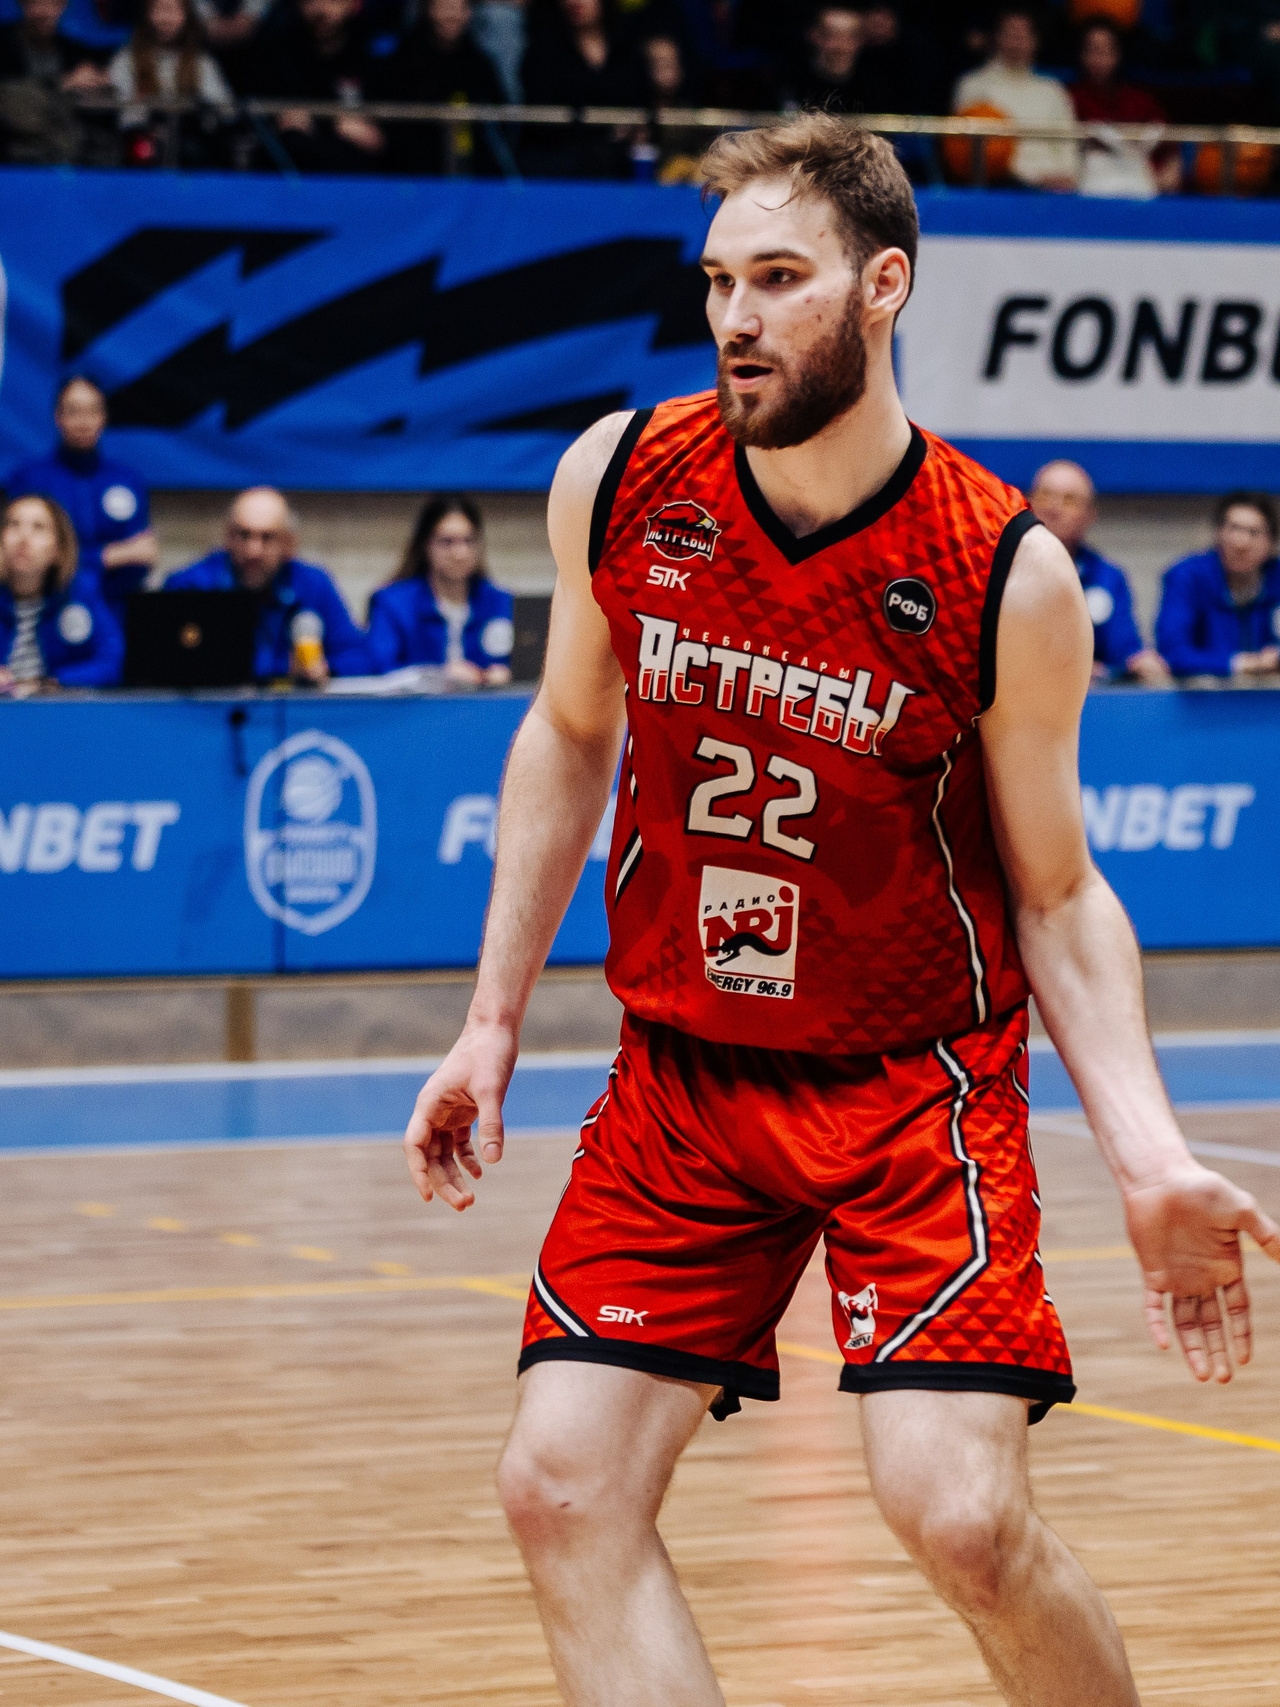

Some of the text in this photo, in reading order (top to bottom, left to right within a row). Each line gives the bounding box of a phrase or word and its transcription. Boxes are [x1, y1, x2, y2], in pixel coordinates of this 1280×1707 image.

[646, 564, 692, 591] STK
[888, 592, 929, 622] РФБ
[682, 627, 851, 680] ЧЕБОКСАРЫ
[632, 612, 917, 757] ЯСТРЕБЫ
[686, 735, 818, 860] 22
[703, 893, 777, 914] РАДИО
[756, 979, 793, 998] 96.9
[597, 1304, 650, 1327] STK
